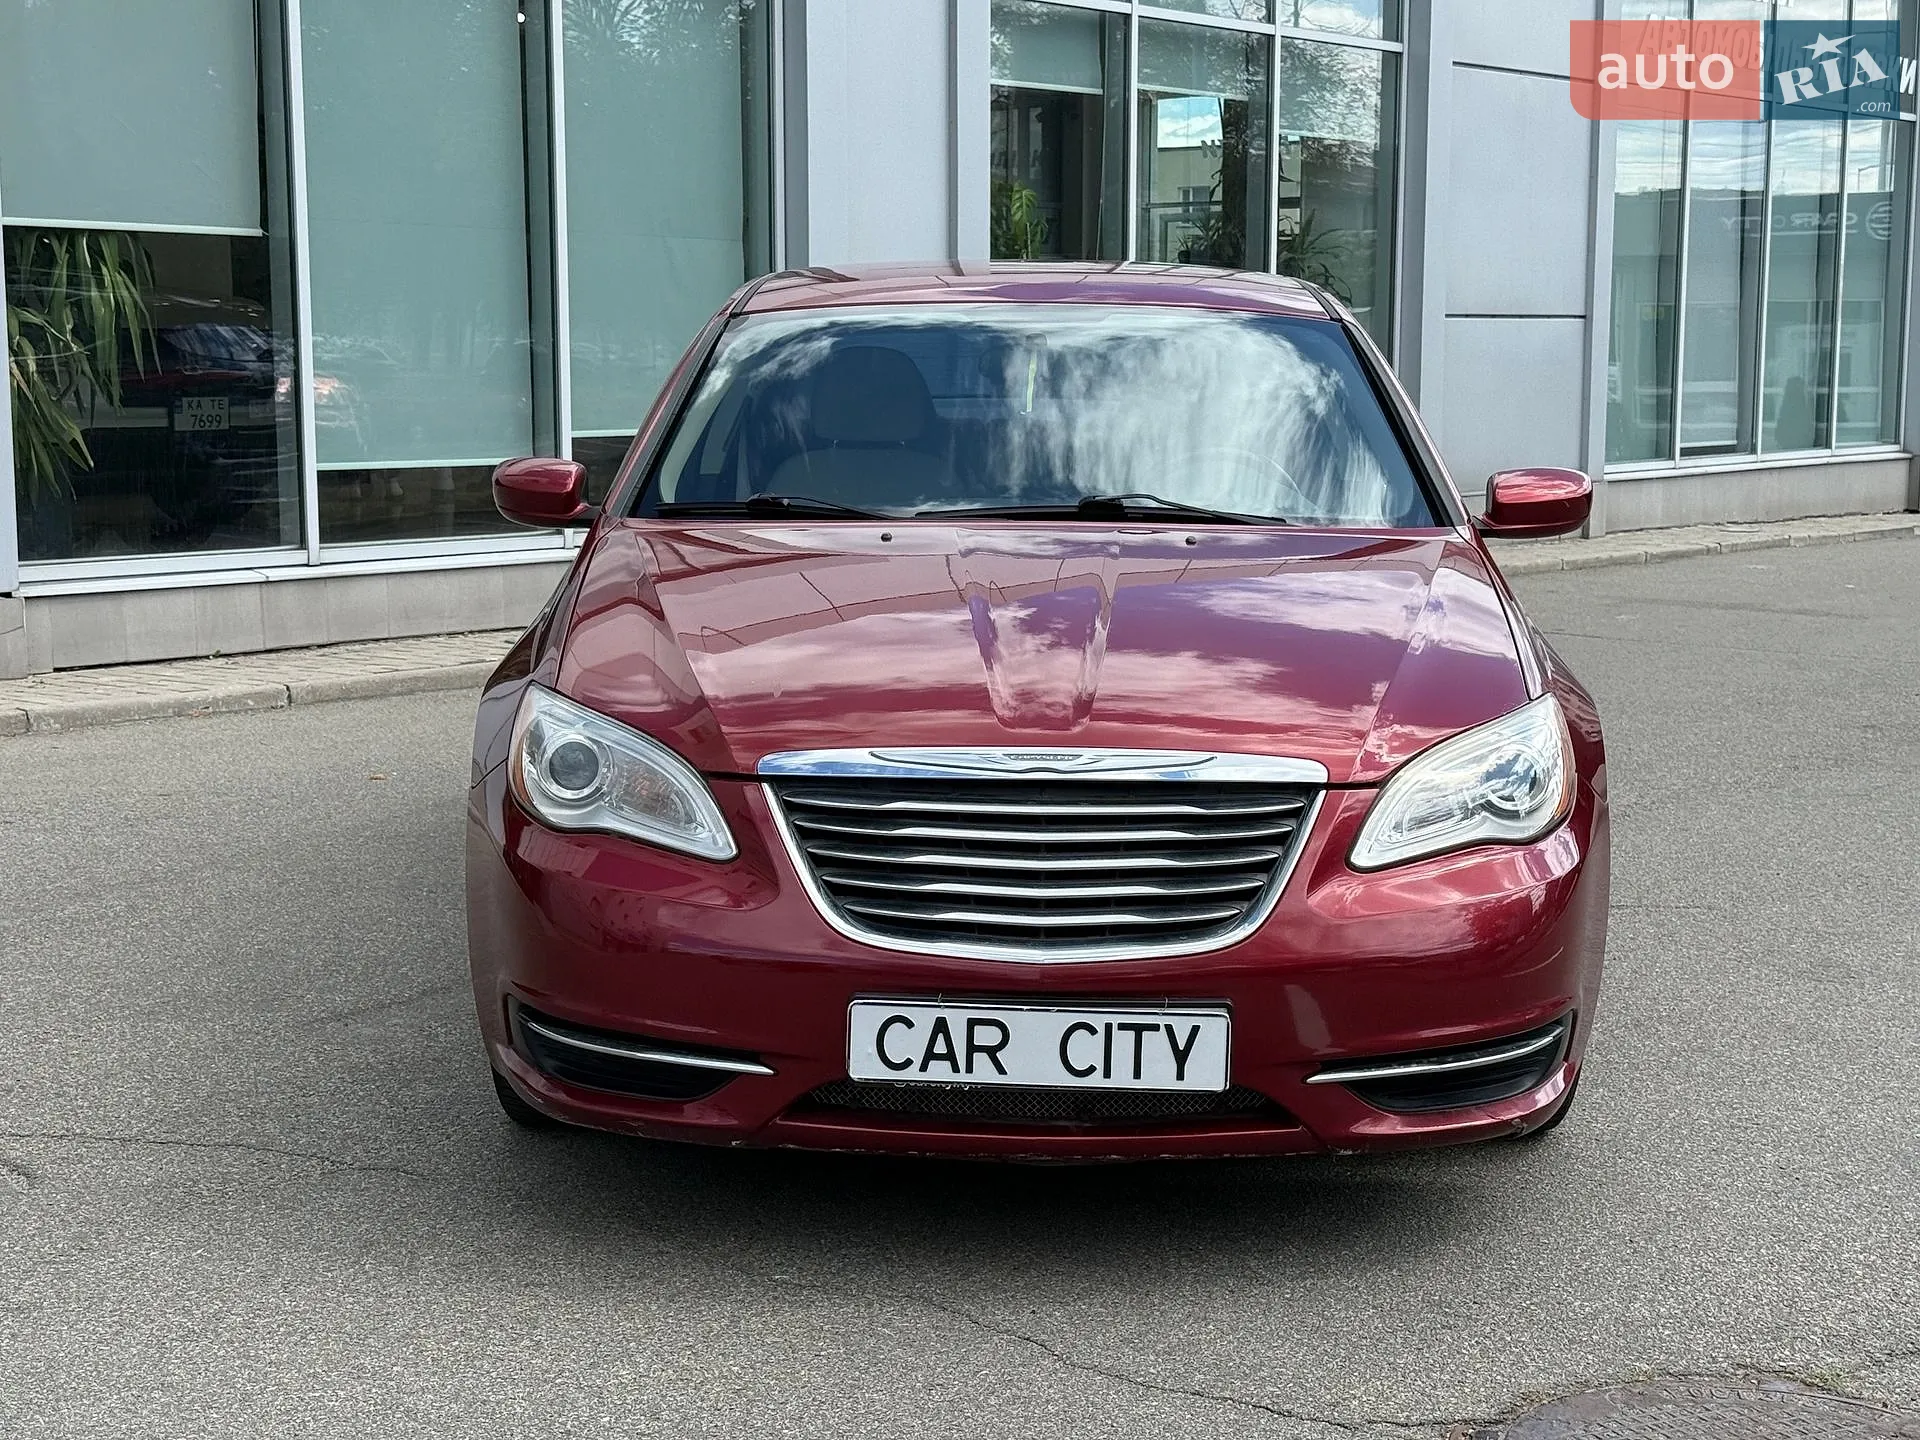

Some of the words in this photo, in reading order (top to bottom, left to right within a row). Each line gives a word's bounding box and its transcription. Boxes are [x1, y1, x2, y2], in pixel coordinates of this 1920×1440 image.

[190, 414, 222, 429] 7699
[875, 1014, 1011, 1076] CAR
[1059, 1021, 1202, 1082] CITY
